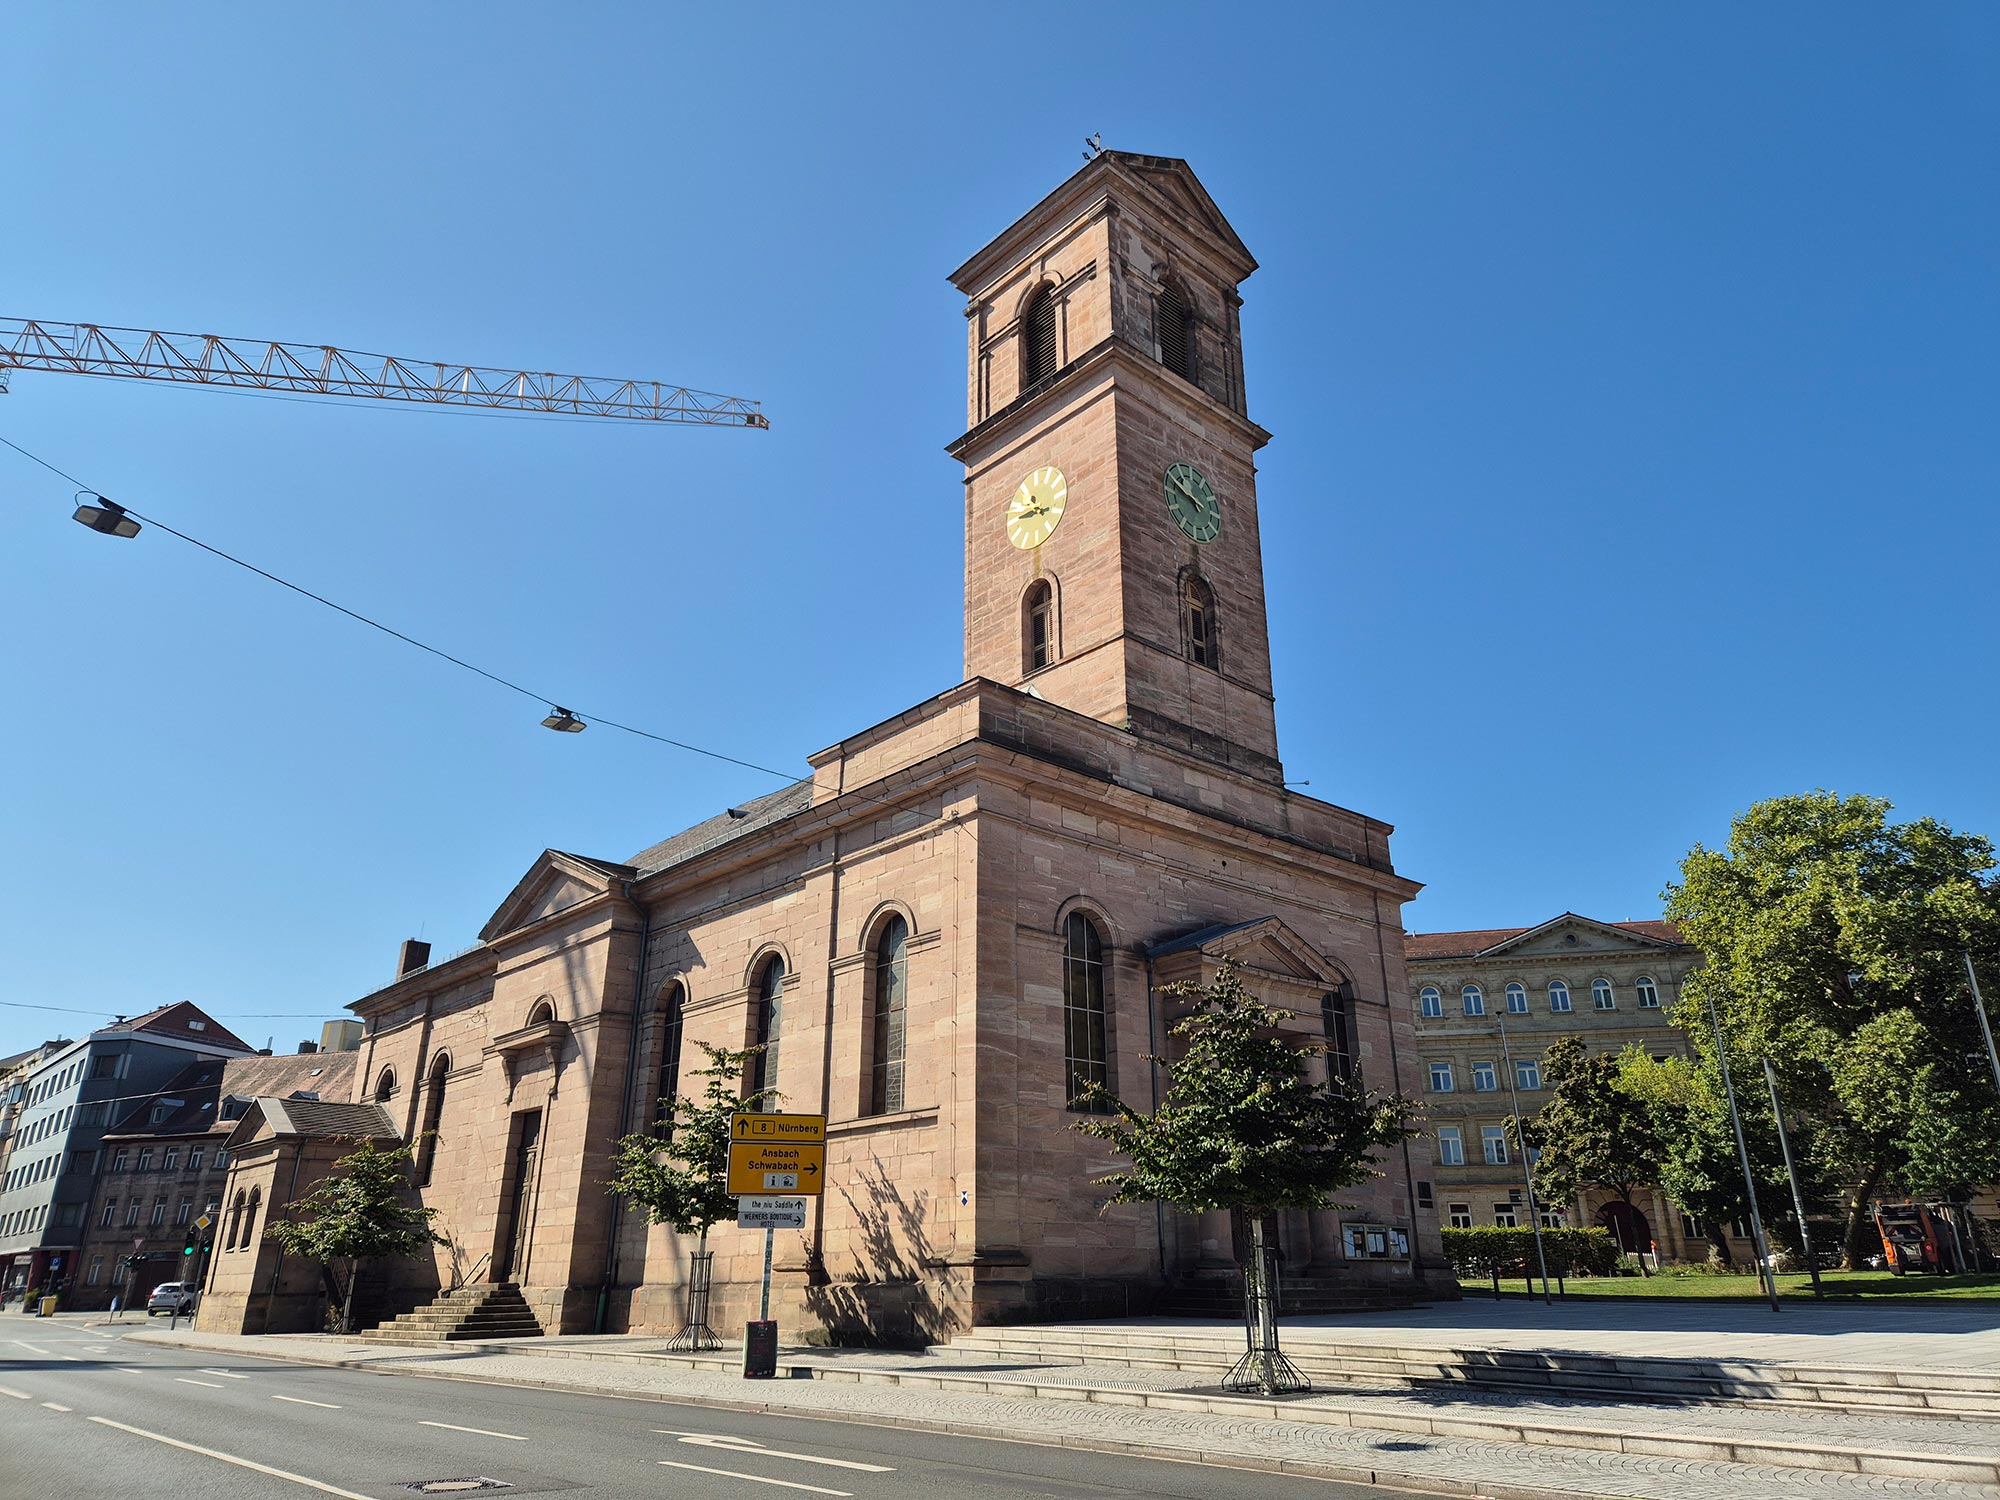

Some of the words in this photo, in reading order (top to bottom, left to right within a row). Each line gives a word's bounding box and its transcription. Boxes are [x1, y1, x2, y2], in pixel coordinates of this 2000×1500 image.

[761, 1123, 767, 1132] 8
[778, 1124, 819, 1134] Nürnberg
[761, 1148, 800, 1158] Ansbach
[748, 1160, 799, 1170] Schwabach
[774, 1200, 793, 1208] Saddle
